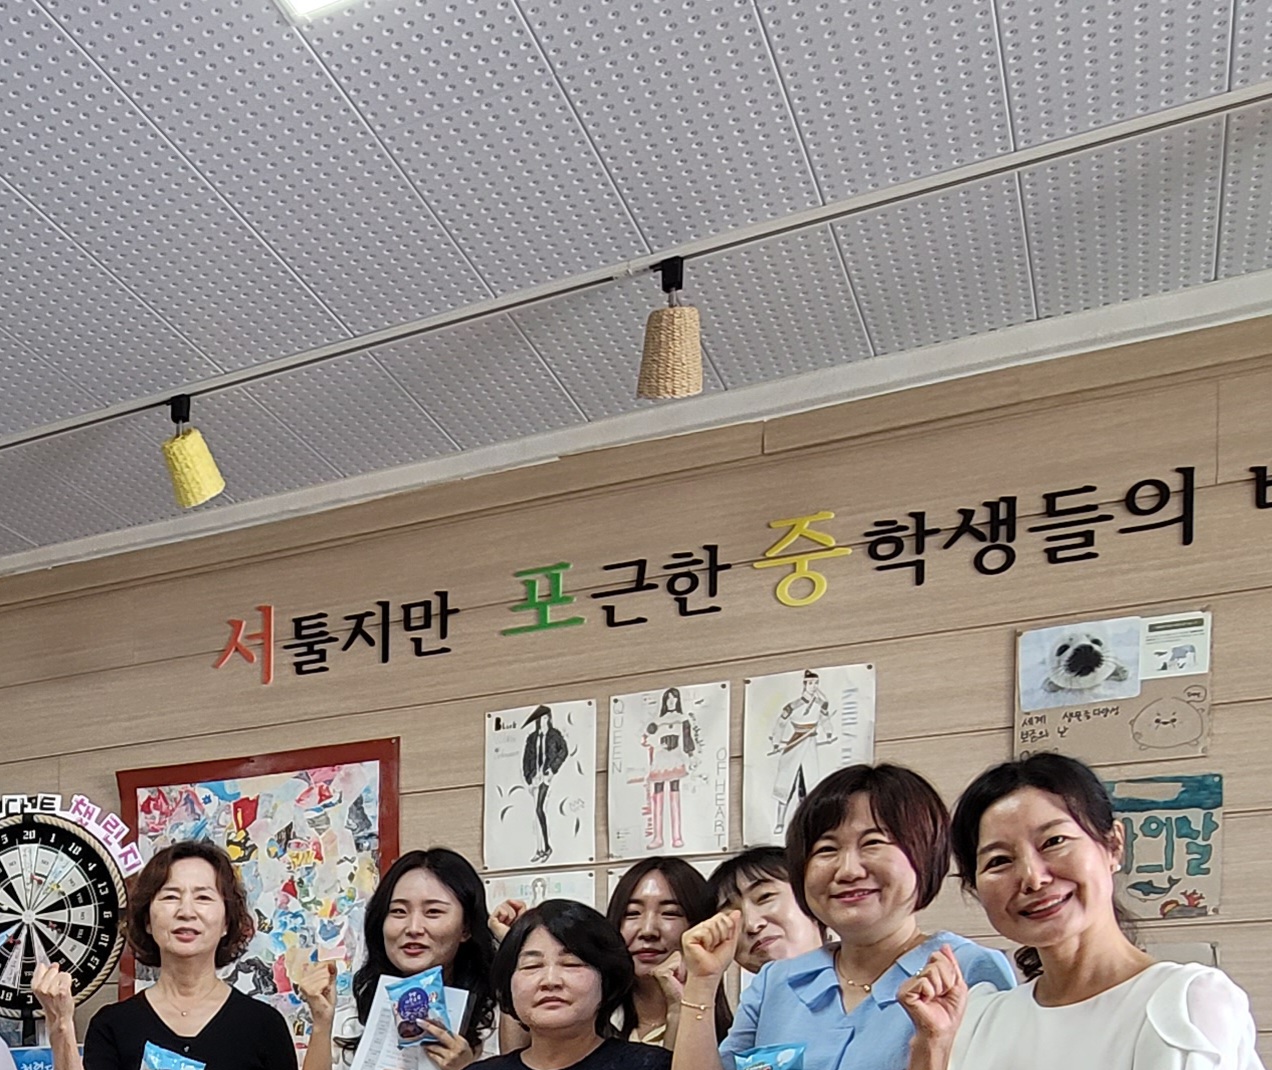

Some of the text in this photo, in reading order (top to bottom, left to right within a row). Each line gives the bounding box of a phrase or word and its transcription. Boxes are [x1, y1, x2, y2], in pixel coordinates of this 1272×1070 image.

[211, 590, 459, 686] 서툴지만
[500, 543, 733, 638] 포근한
[753, 465, 1196, 608] 중학생들의
[23, 829, 36, 841] 20
[70, 798, 143, 873] 챌린지
[87, 956, 100, 971] 15
